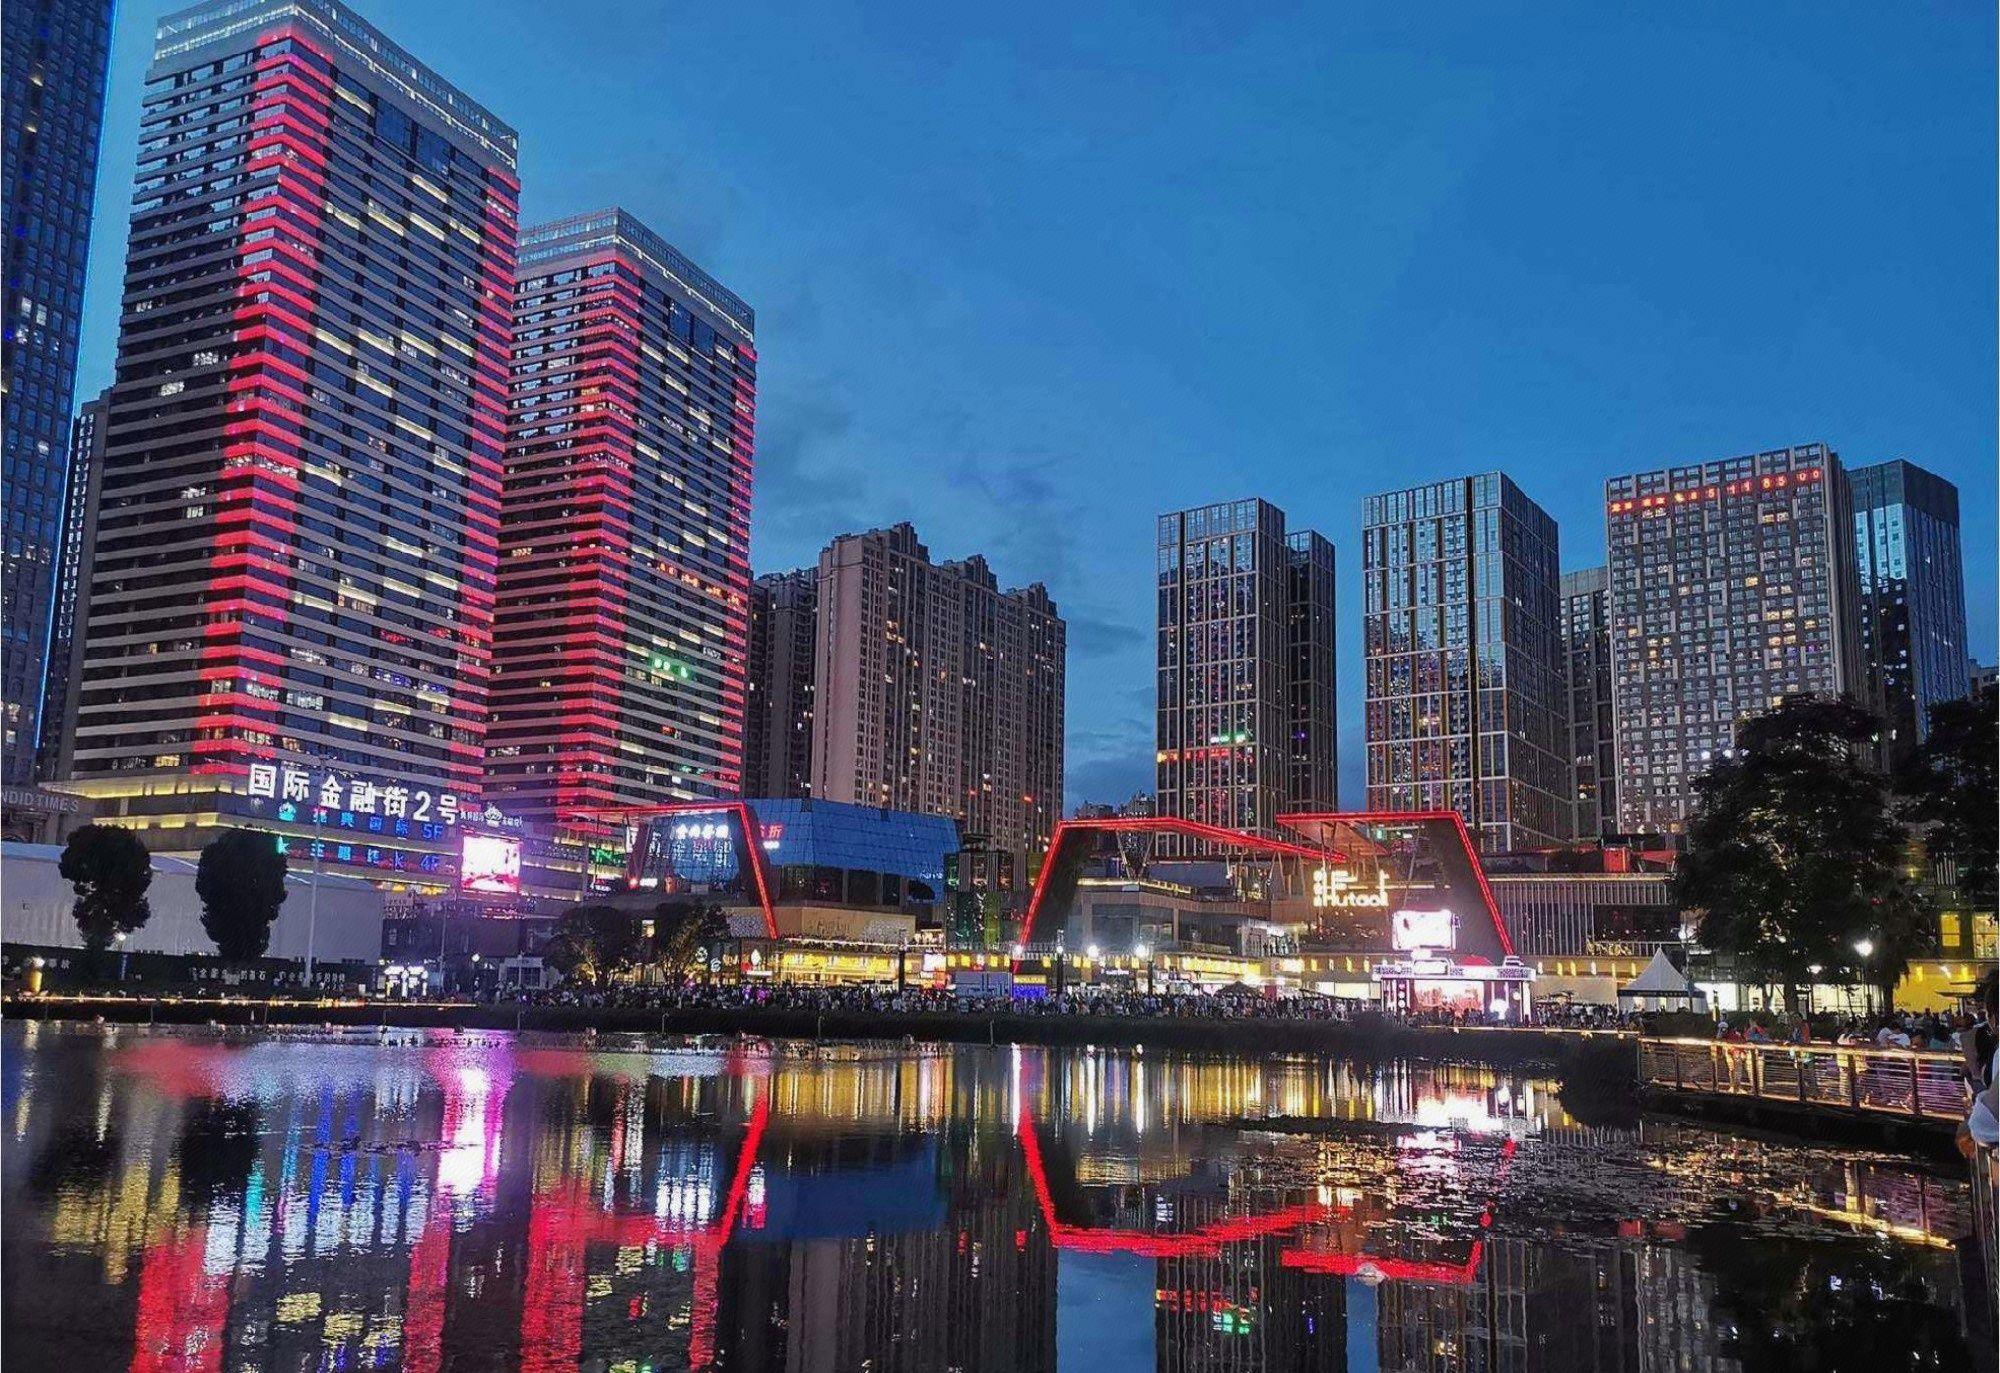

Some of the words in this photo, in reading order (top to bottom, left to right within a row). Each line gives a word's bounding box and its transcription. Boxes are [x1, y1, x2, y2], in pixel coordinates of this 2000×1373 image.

[247, 763, 459, 825] 国际金融街2号
